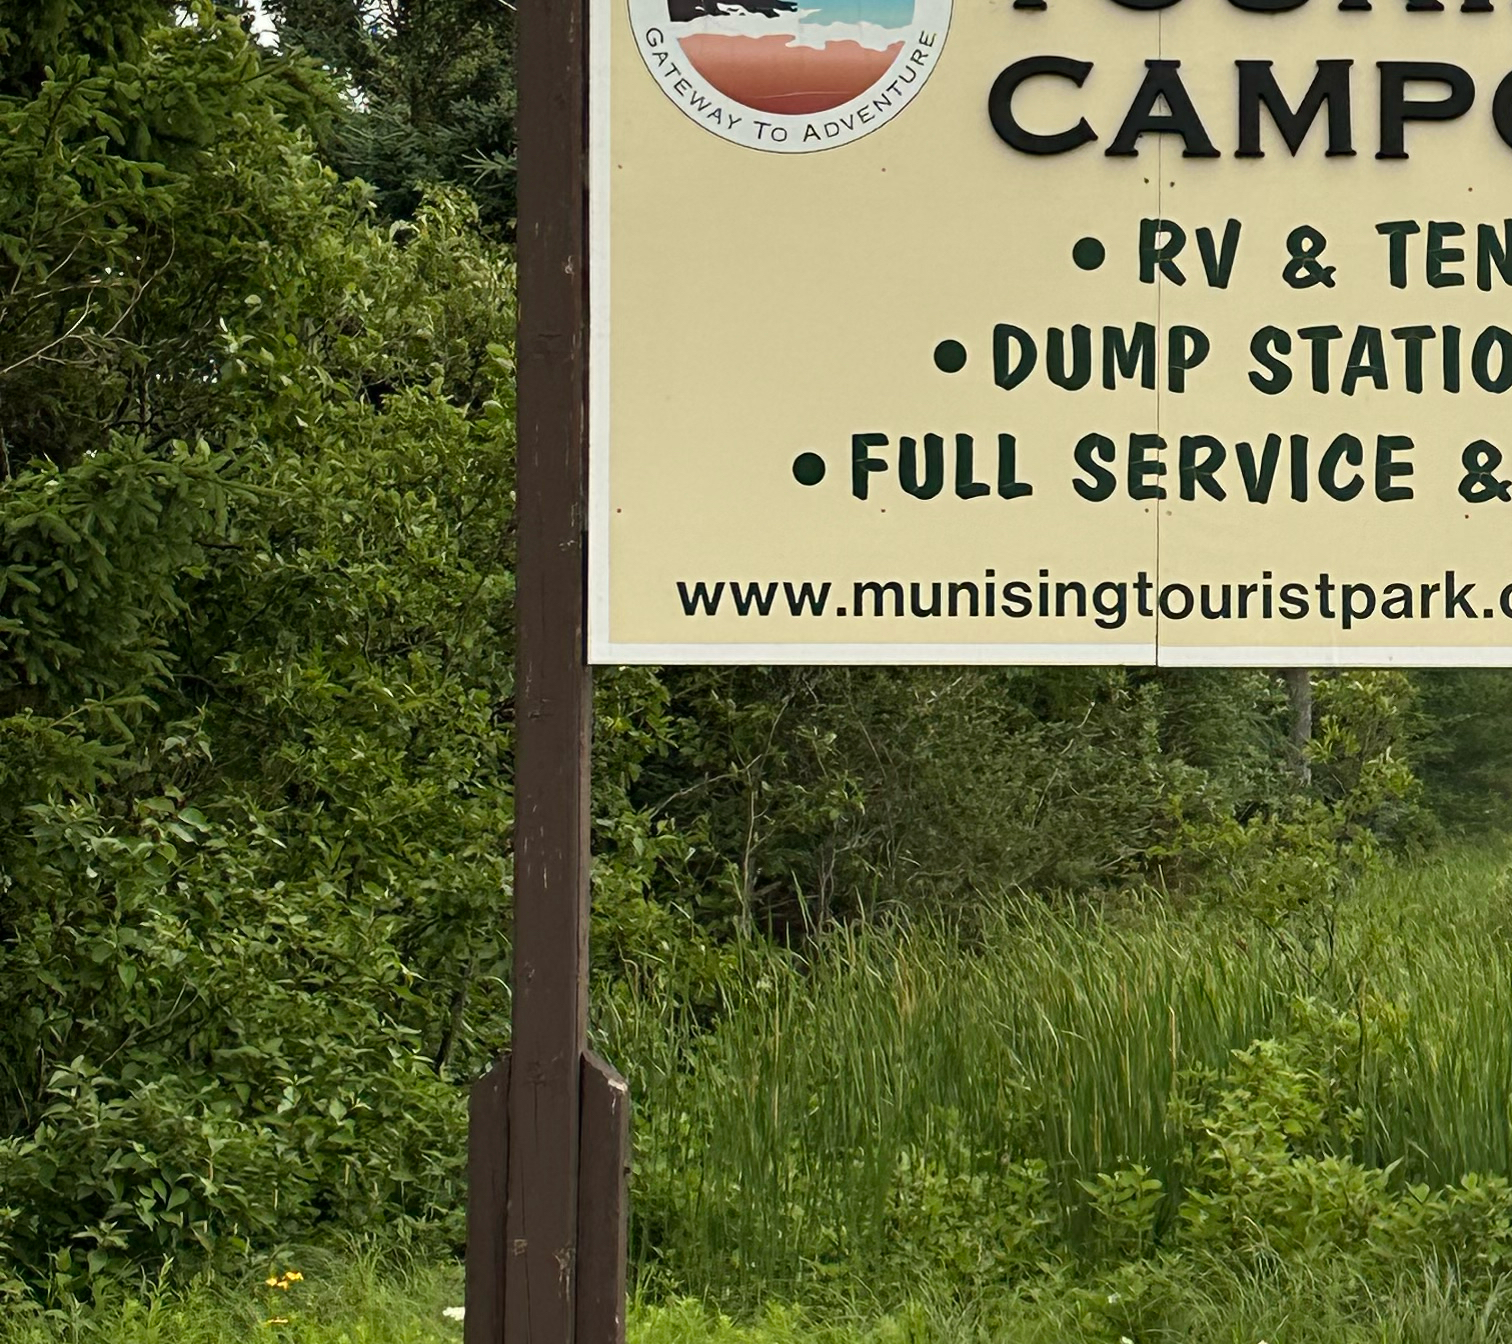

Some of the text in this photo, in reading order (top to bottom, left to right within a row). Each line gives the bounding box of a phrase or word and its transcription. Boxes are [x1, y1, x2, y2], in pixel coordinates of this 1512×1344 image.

[645, 26, 938, 143] GATEWAY TO ADVENTURE
[1138, 217, 1242, 290] RV
[1282, 224, 1337, 290] &
[992, 321, 1210, 394] DUMP
[851, 432, 1033, 501] FULL
[1071, 432, 1415, 504] SERVICE
[1457, 439, 1512, 504] &
